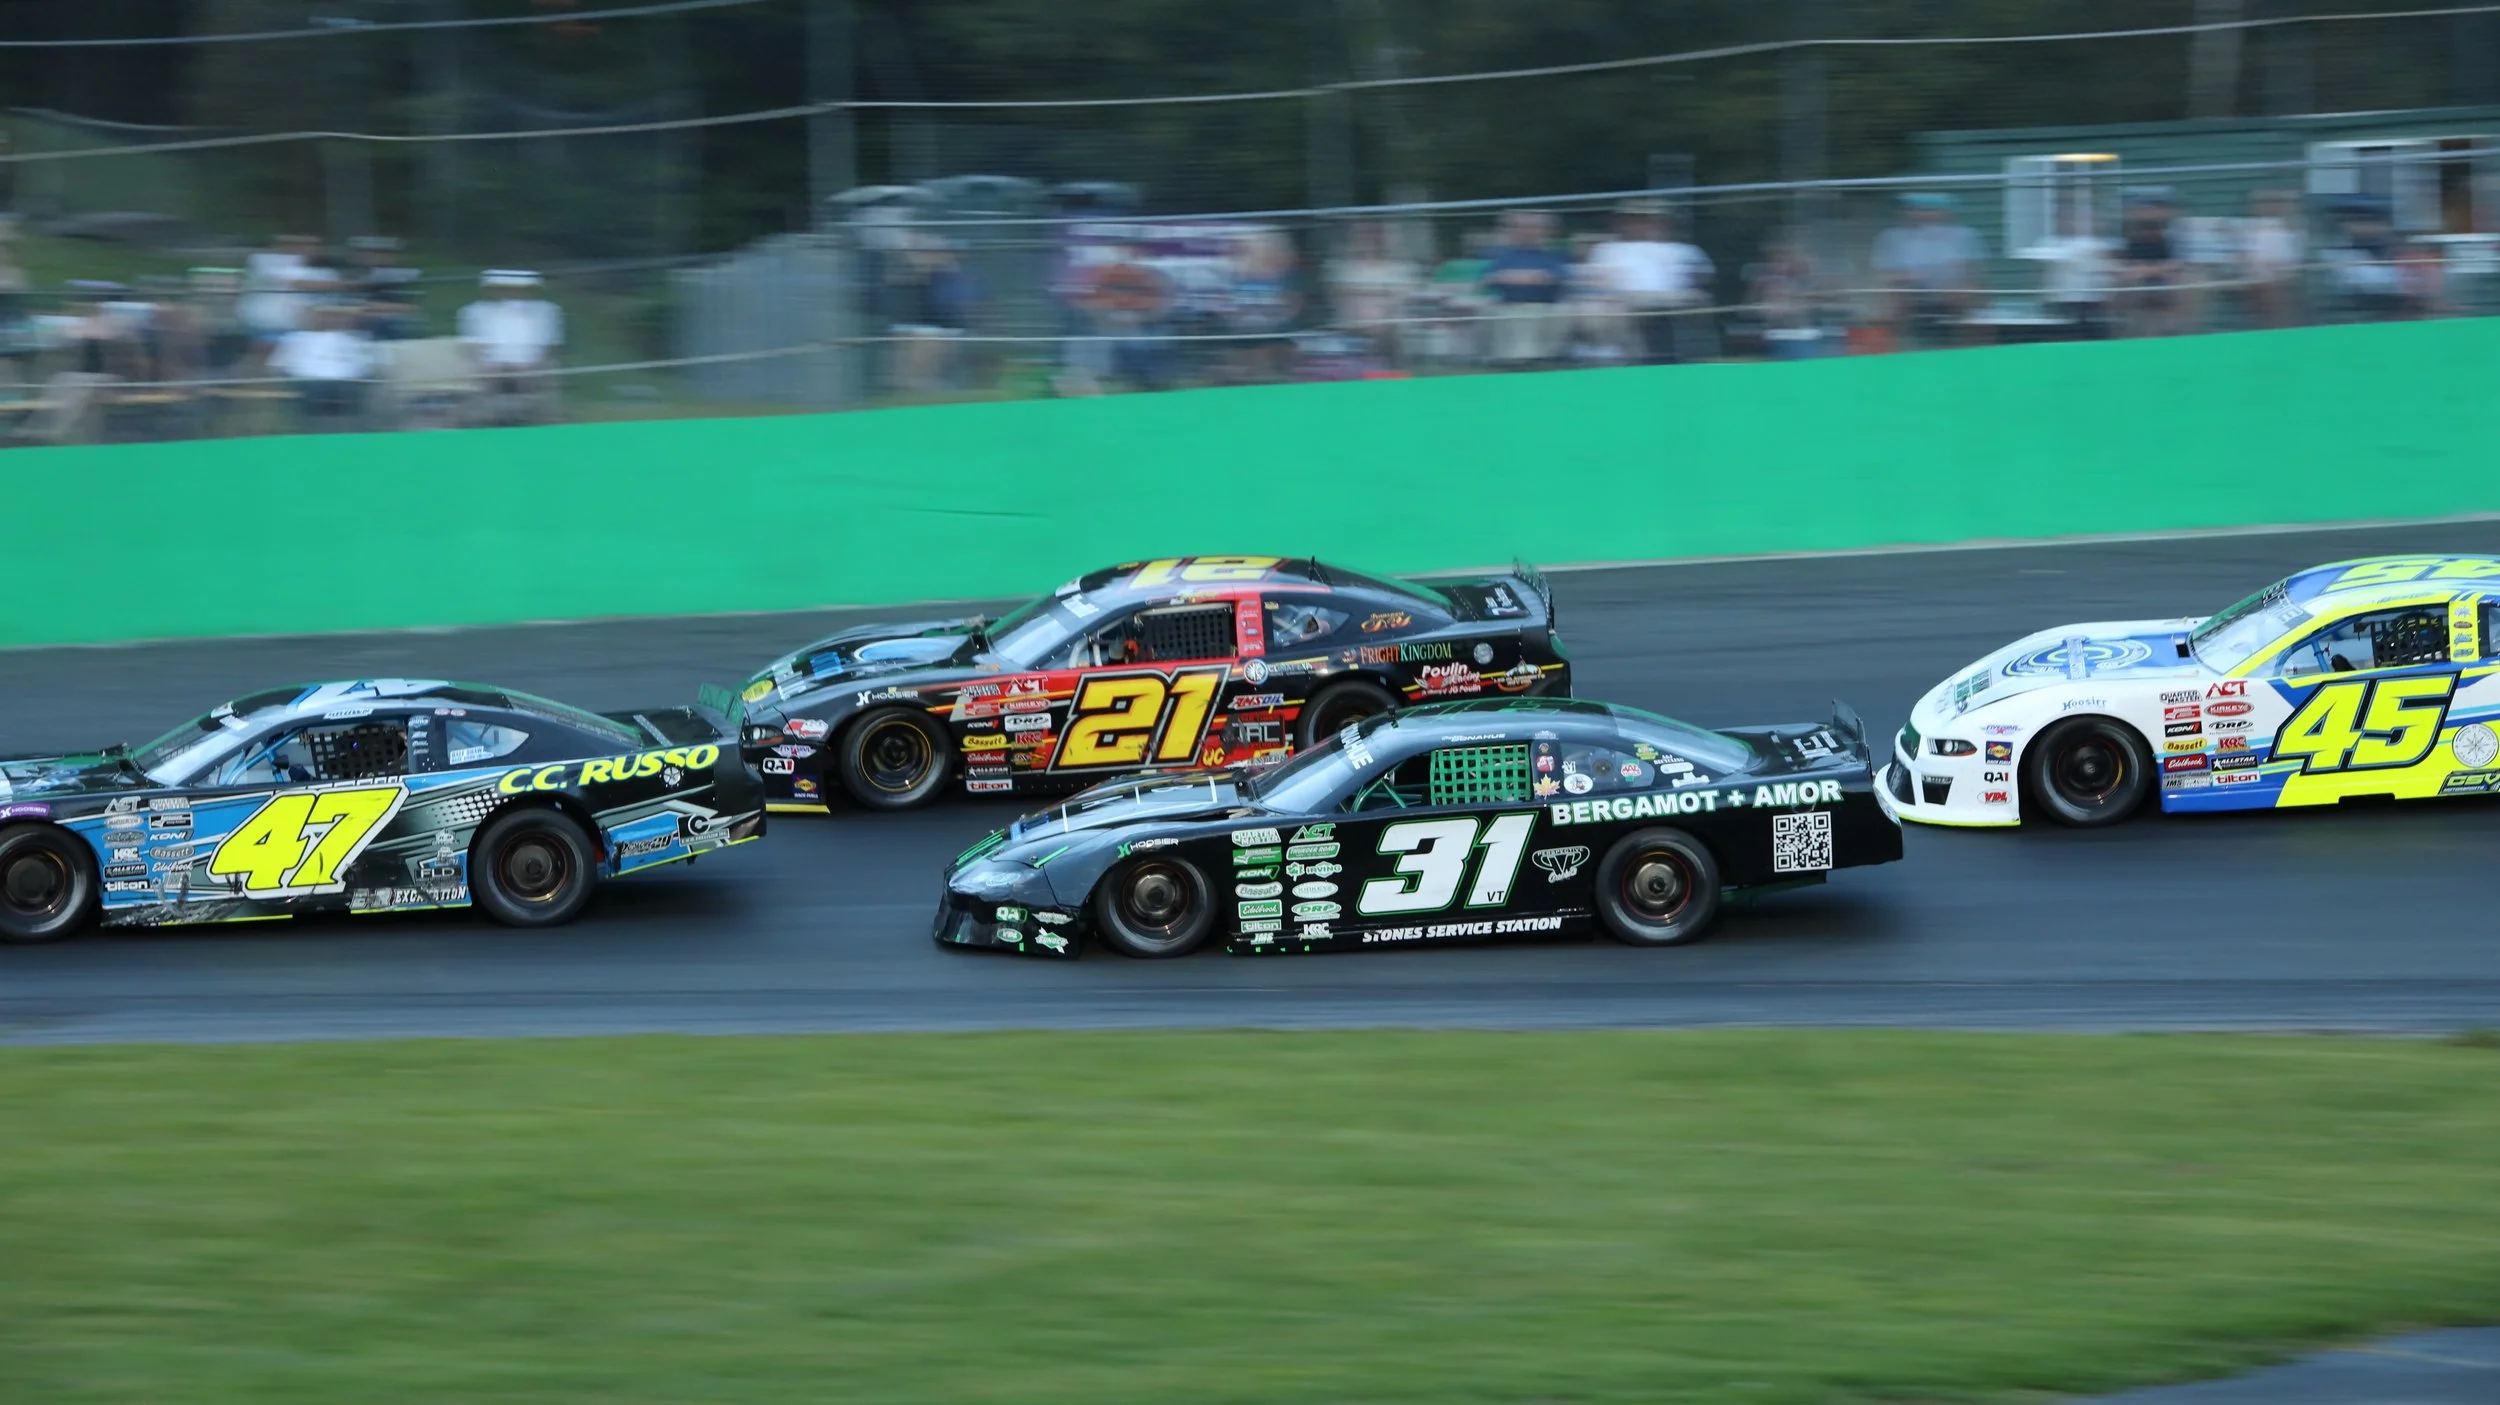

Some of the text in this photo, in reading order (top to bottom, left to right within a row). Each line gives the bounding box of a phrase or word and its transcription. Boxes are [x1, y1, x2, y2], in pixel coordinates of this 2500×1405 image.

[1422, 662, 1468, 678] Poulin
[2160, 690, 2198, 700] QUARTER
[2206, 680, 2249, 698] ACT
[1235, 694, 1283, 707] AMSOIL
[1057, 672, 1220, 766] 21
[2276, 673, 2457, 773] 45
[2167, 725, 2194, 735] KONI
[2167, 739, 2204, 751] Bassett
[2167, 757, 2204, 770] Edelbrock
[2220, 756, 2256, 765] ALLSTAR
[499, 744, 720, 794] C.C. RUSSO
[2215, 773, 2259, 785] tilton
[969, 781, 1010, 791] tilton
[1552, 790, 1719, 825] BERGAMOT
[1753, 780, 1843, 808] AMOR
[150, 831, 187, 841] KONI
[1289, 822, 1336, 843] ACT
[210, 787, 401, 891] 47
[1130, 837, 1179, 851] HOOSIER
[153, 847, 190, 858] Bassett
[152, 861, 194, 873] Edelbrock
[1307, 864, 1341, 874] IRVING
[1359, 814, 1535, 914] 31
[1236, 867, 1274, 879] KONI
[105, 880, 148, 891] tilton
[1240, 884, 1279, 896] Bassett
[1487, 891, 1505, 903] VT
[1243, 903, 1278, 916] Edelbrock
[1362, 916, 1562, 943] STONES SERVICE STATION
